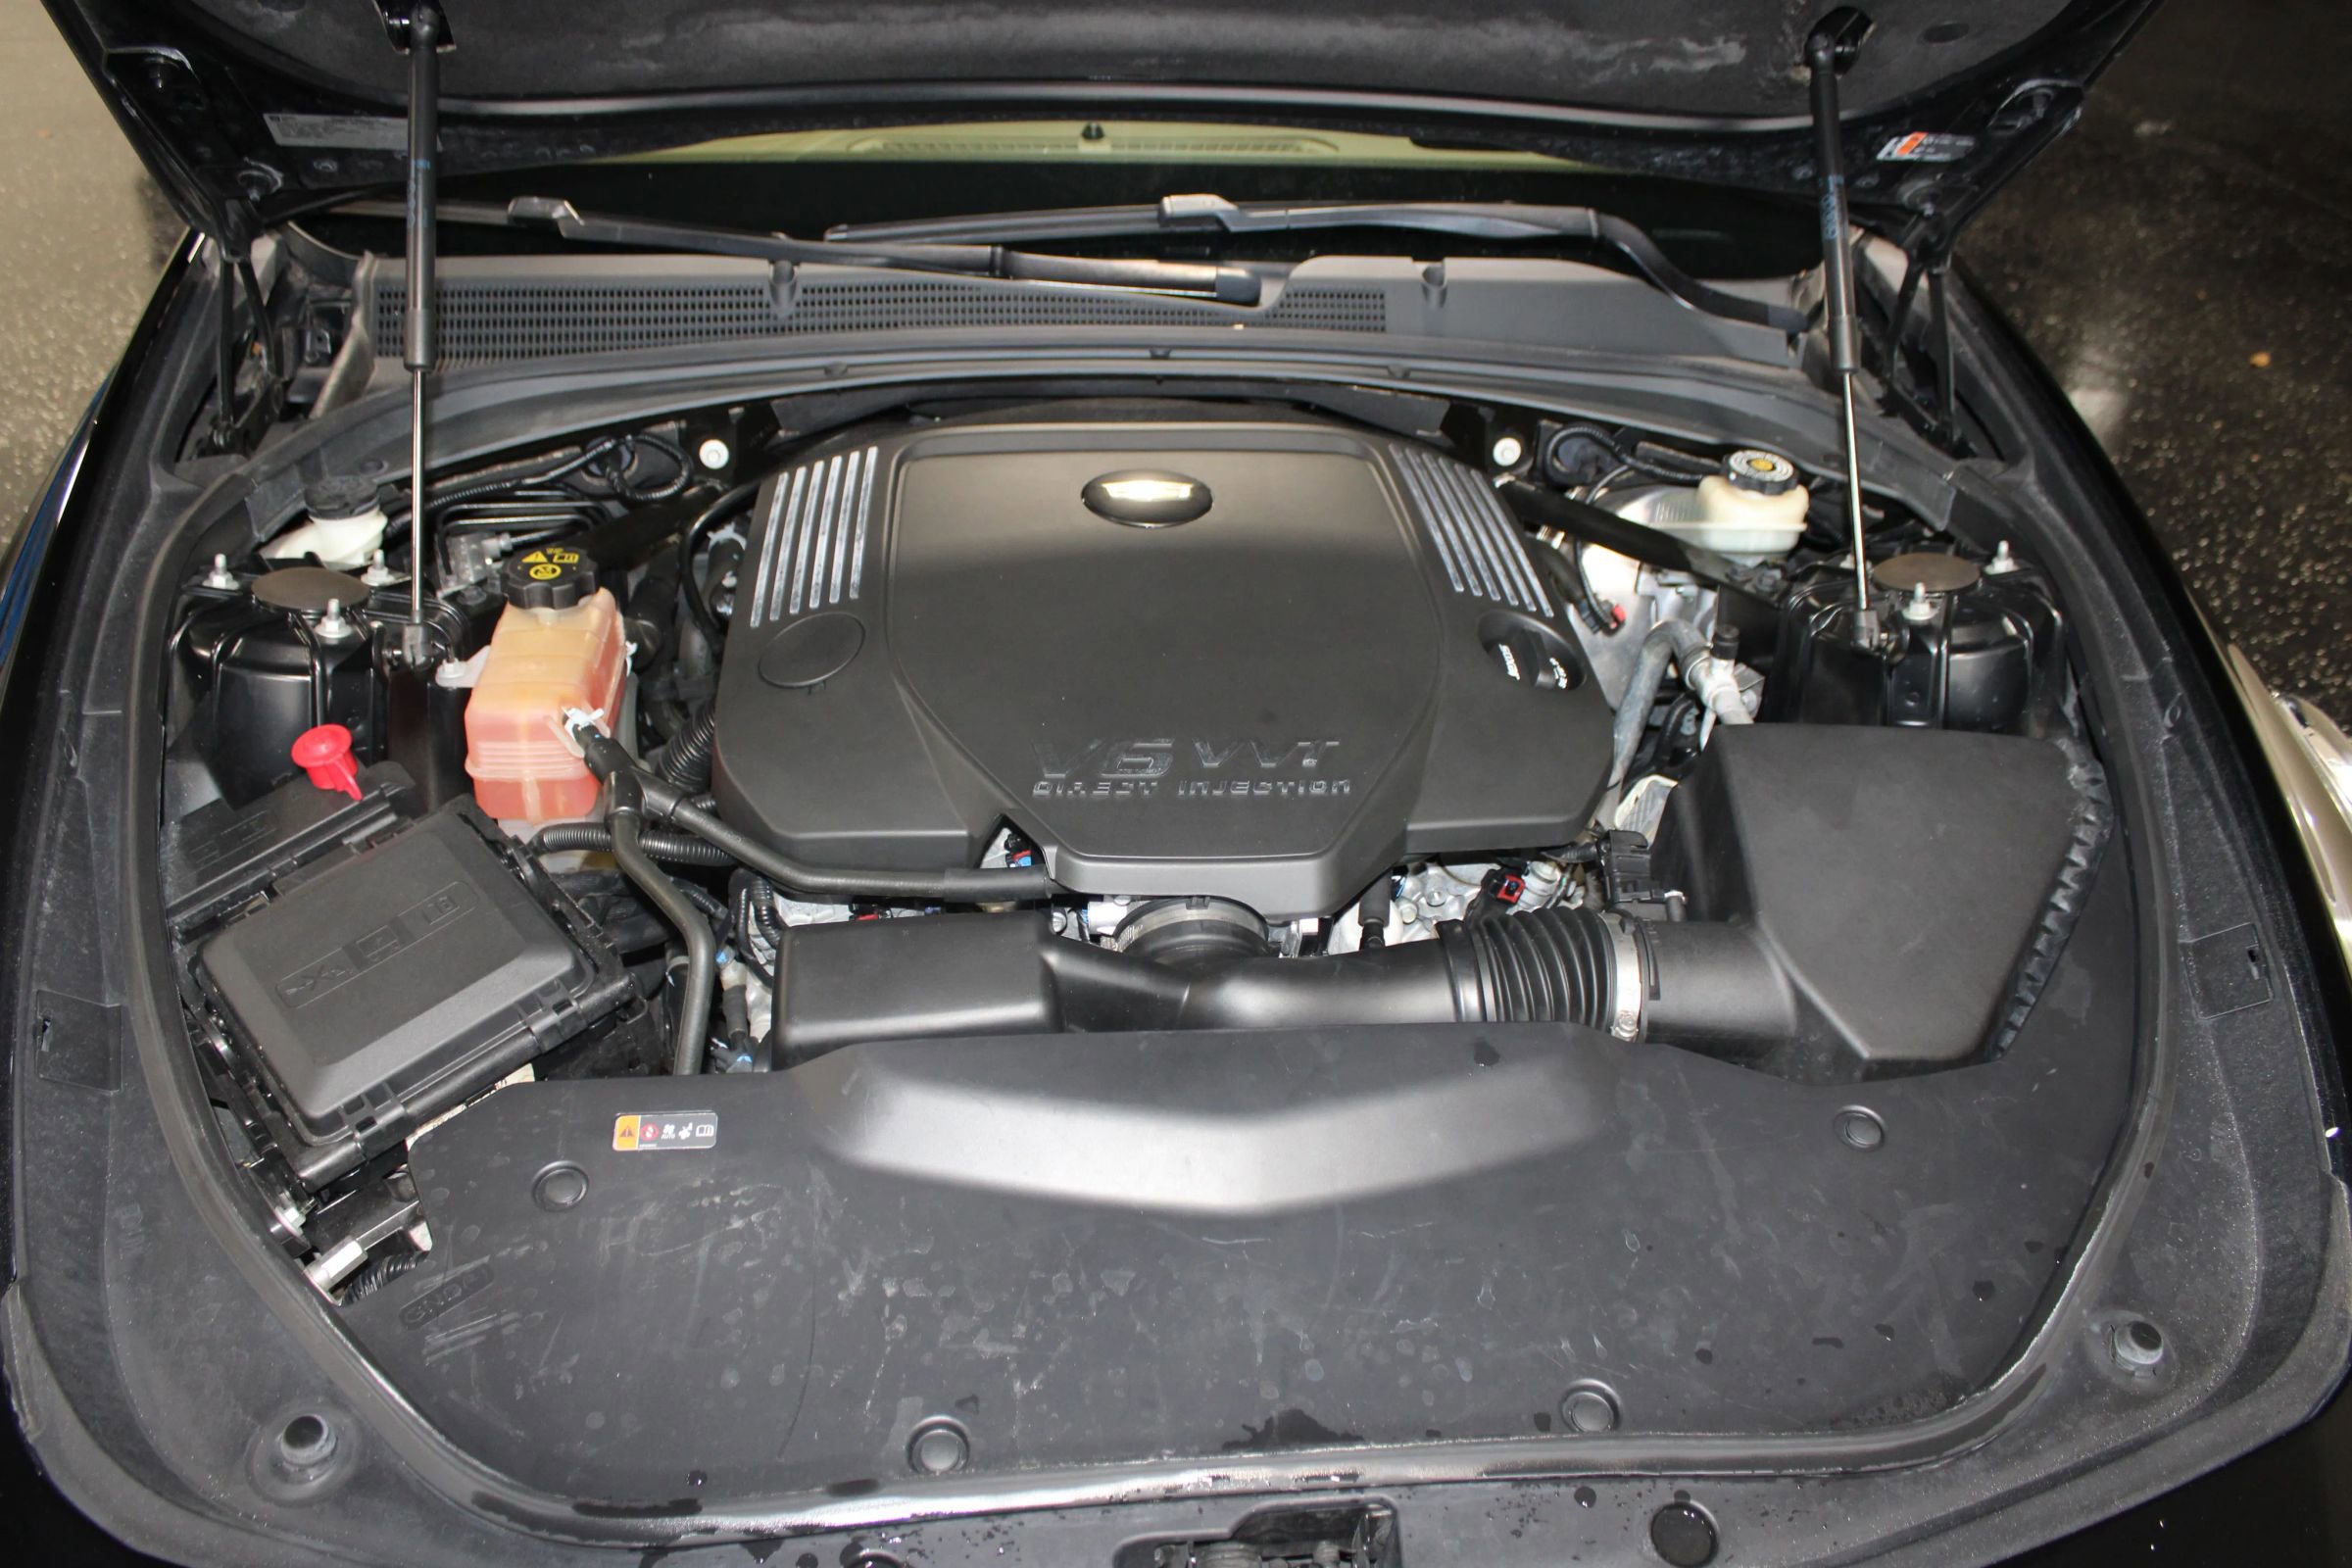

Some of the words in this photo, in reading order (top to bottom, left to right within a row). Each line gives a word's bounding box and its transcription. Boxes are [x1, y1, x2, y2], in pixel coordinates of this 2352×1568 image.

[1030, 738, 1175, 779] V6
[1192, 738, 1341, 767] VVT
[1032, 781, 1158, 798] DIRECT
[1178, 780, 1351, 797] INJECTION
